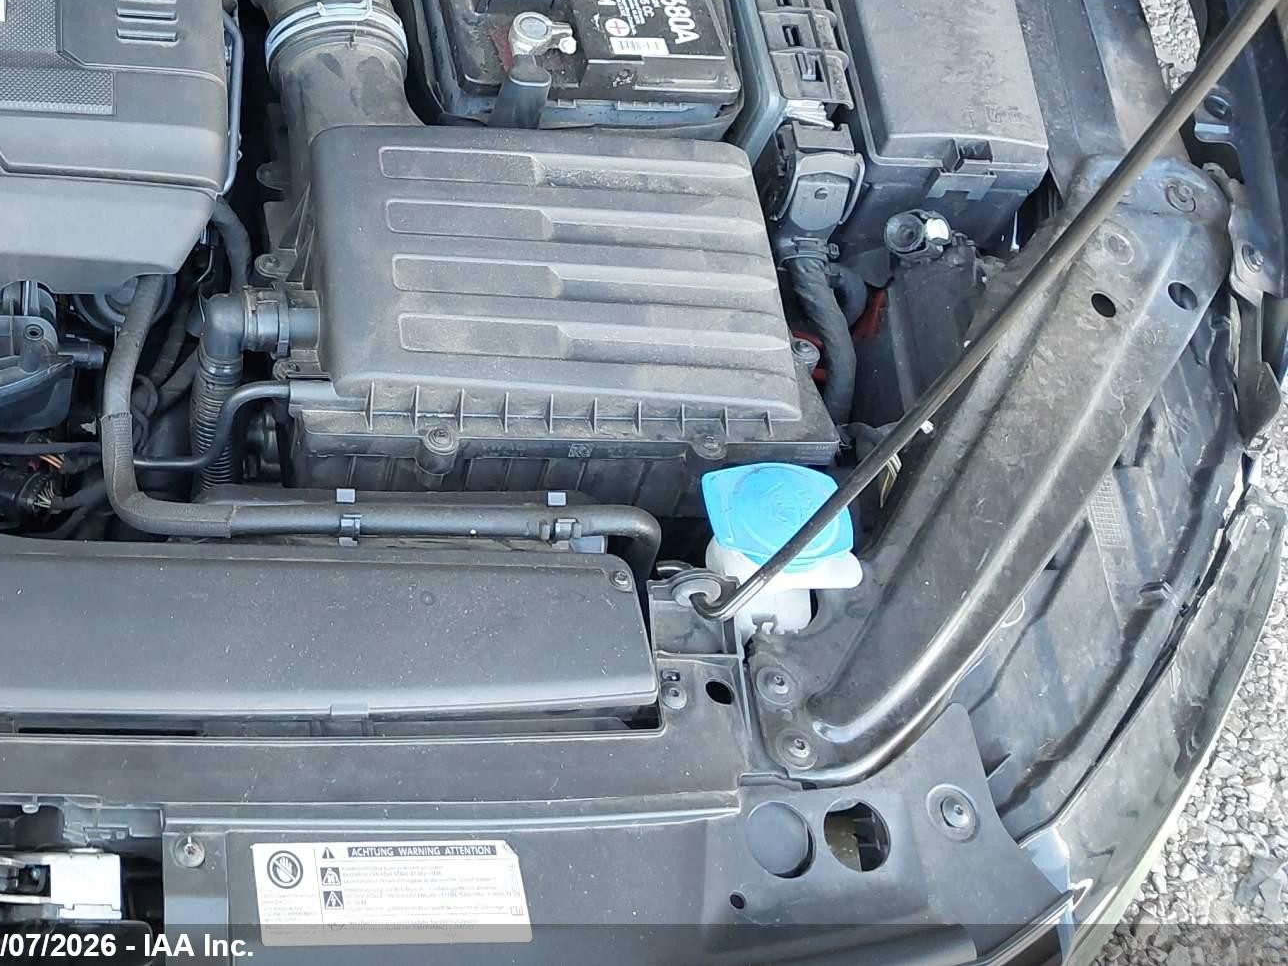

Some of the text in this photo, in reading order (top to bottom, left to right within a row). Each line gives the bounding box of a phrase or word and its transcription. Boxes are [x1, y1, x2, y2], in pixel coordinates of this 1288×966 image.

[351, 845, 492, 857] ACHTUNG WARNING ATTENTION
